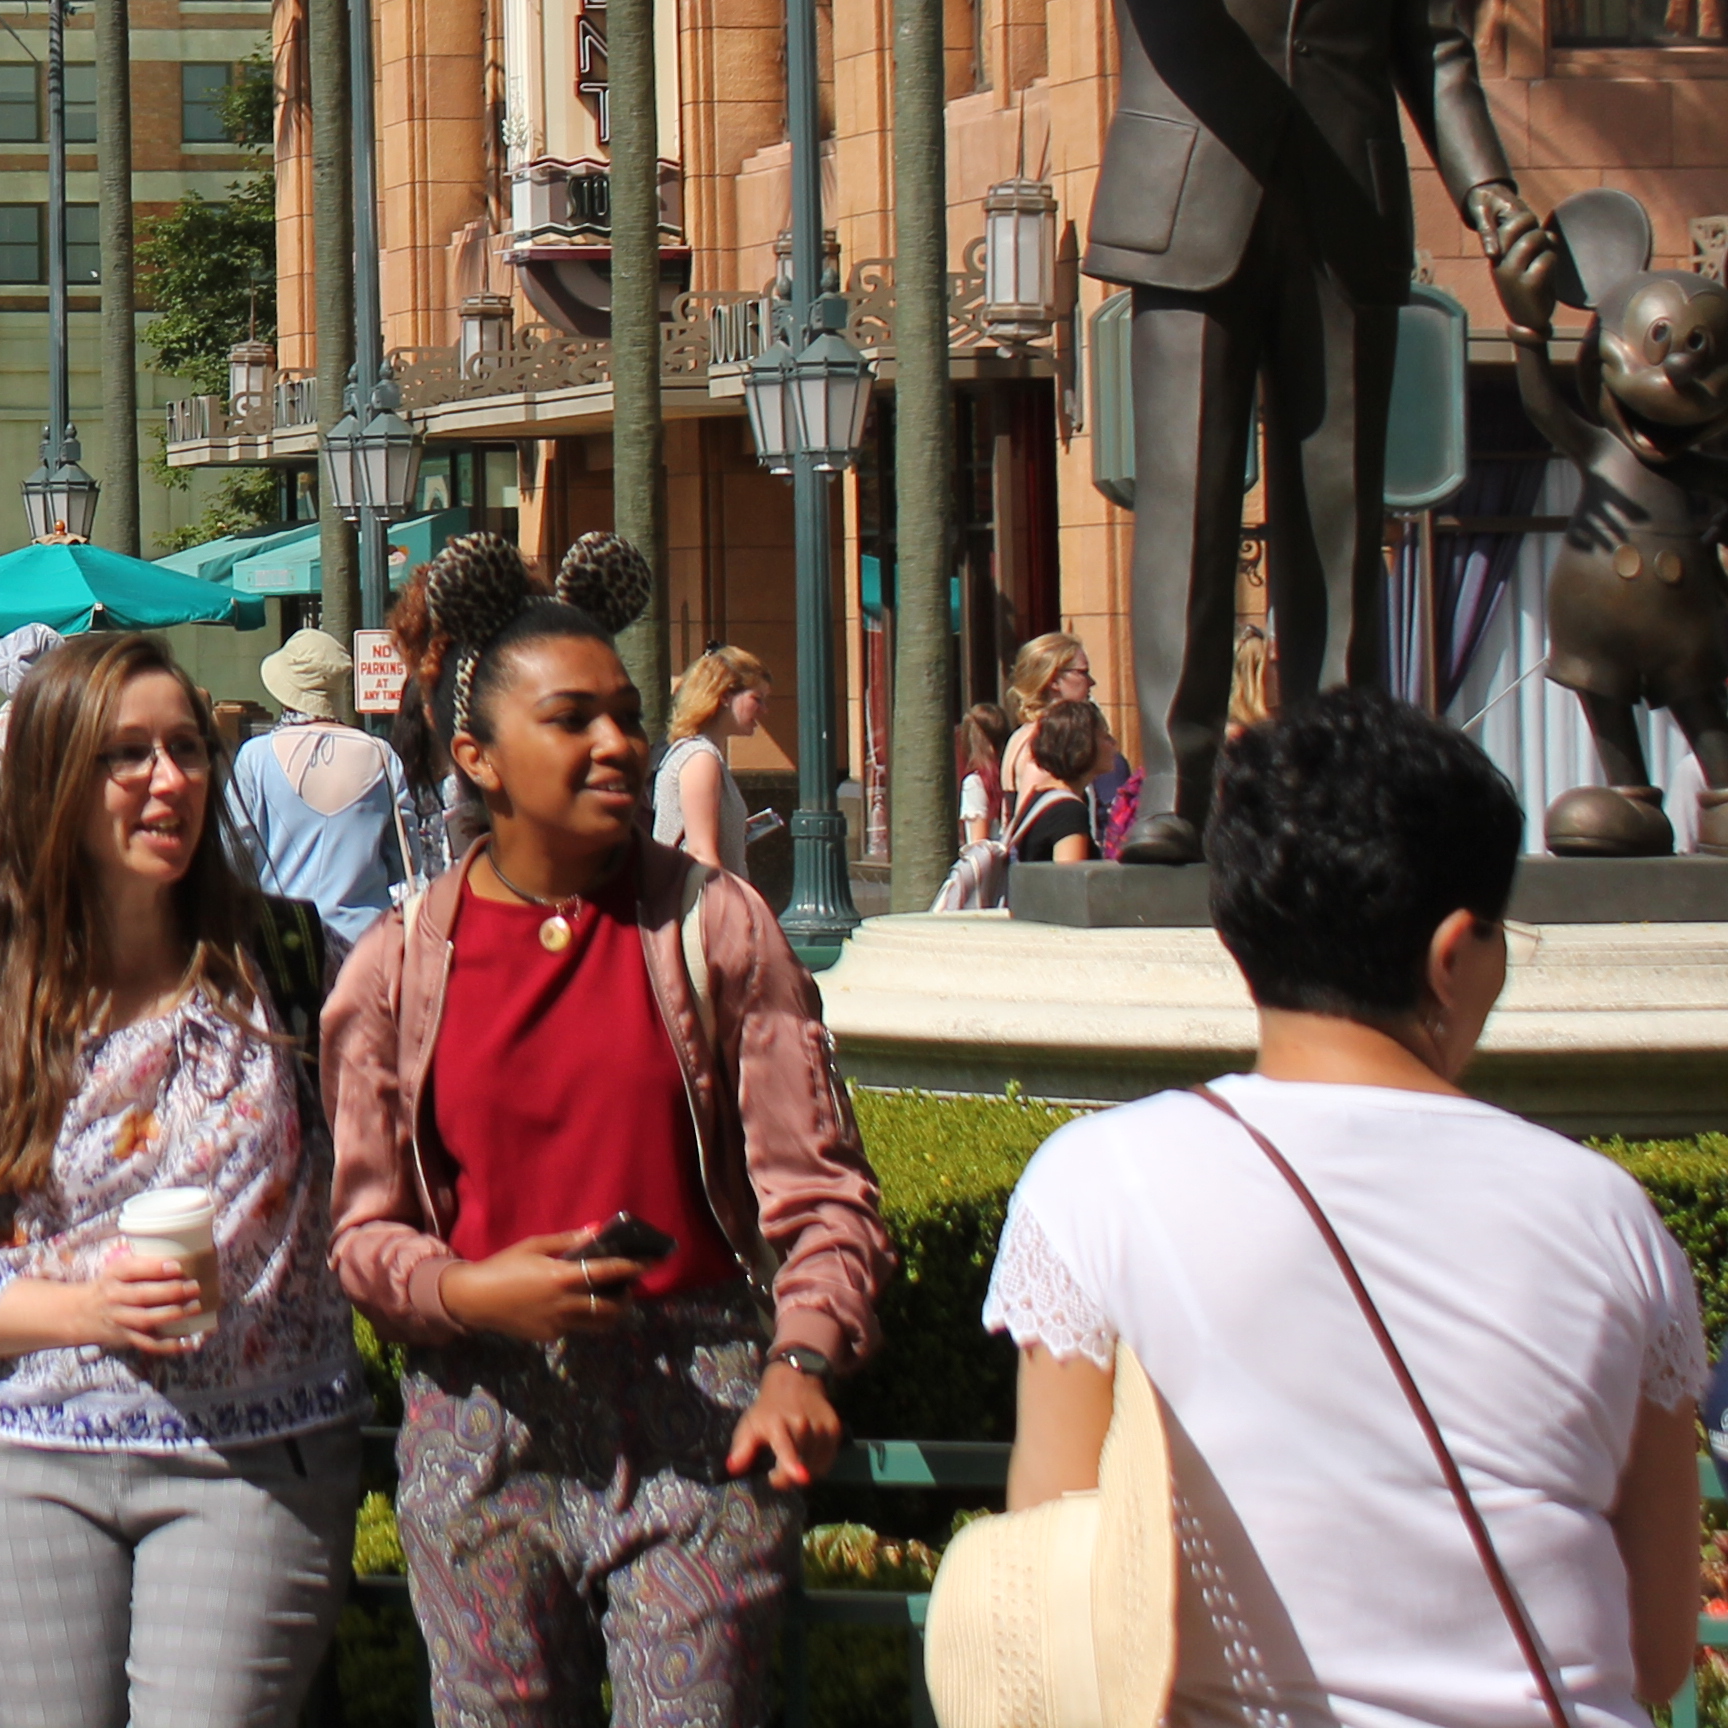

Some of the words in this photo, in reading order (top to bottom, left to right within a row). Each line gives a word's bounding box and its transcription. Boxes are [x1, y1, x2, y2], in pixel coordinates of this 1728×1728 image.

[372, 644, 393, 658] NO
[360, 662, 404, 675] PARKING
[375, 678, 389, 688] AT
[363, 690, 379, 700] ANY
[382, 690, 402, 700] TIME
